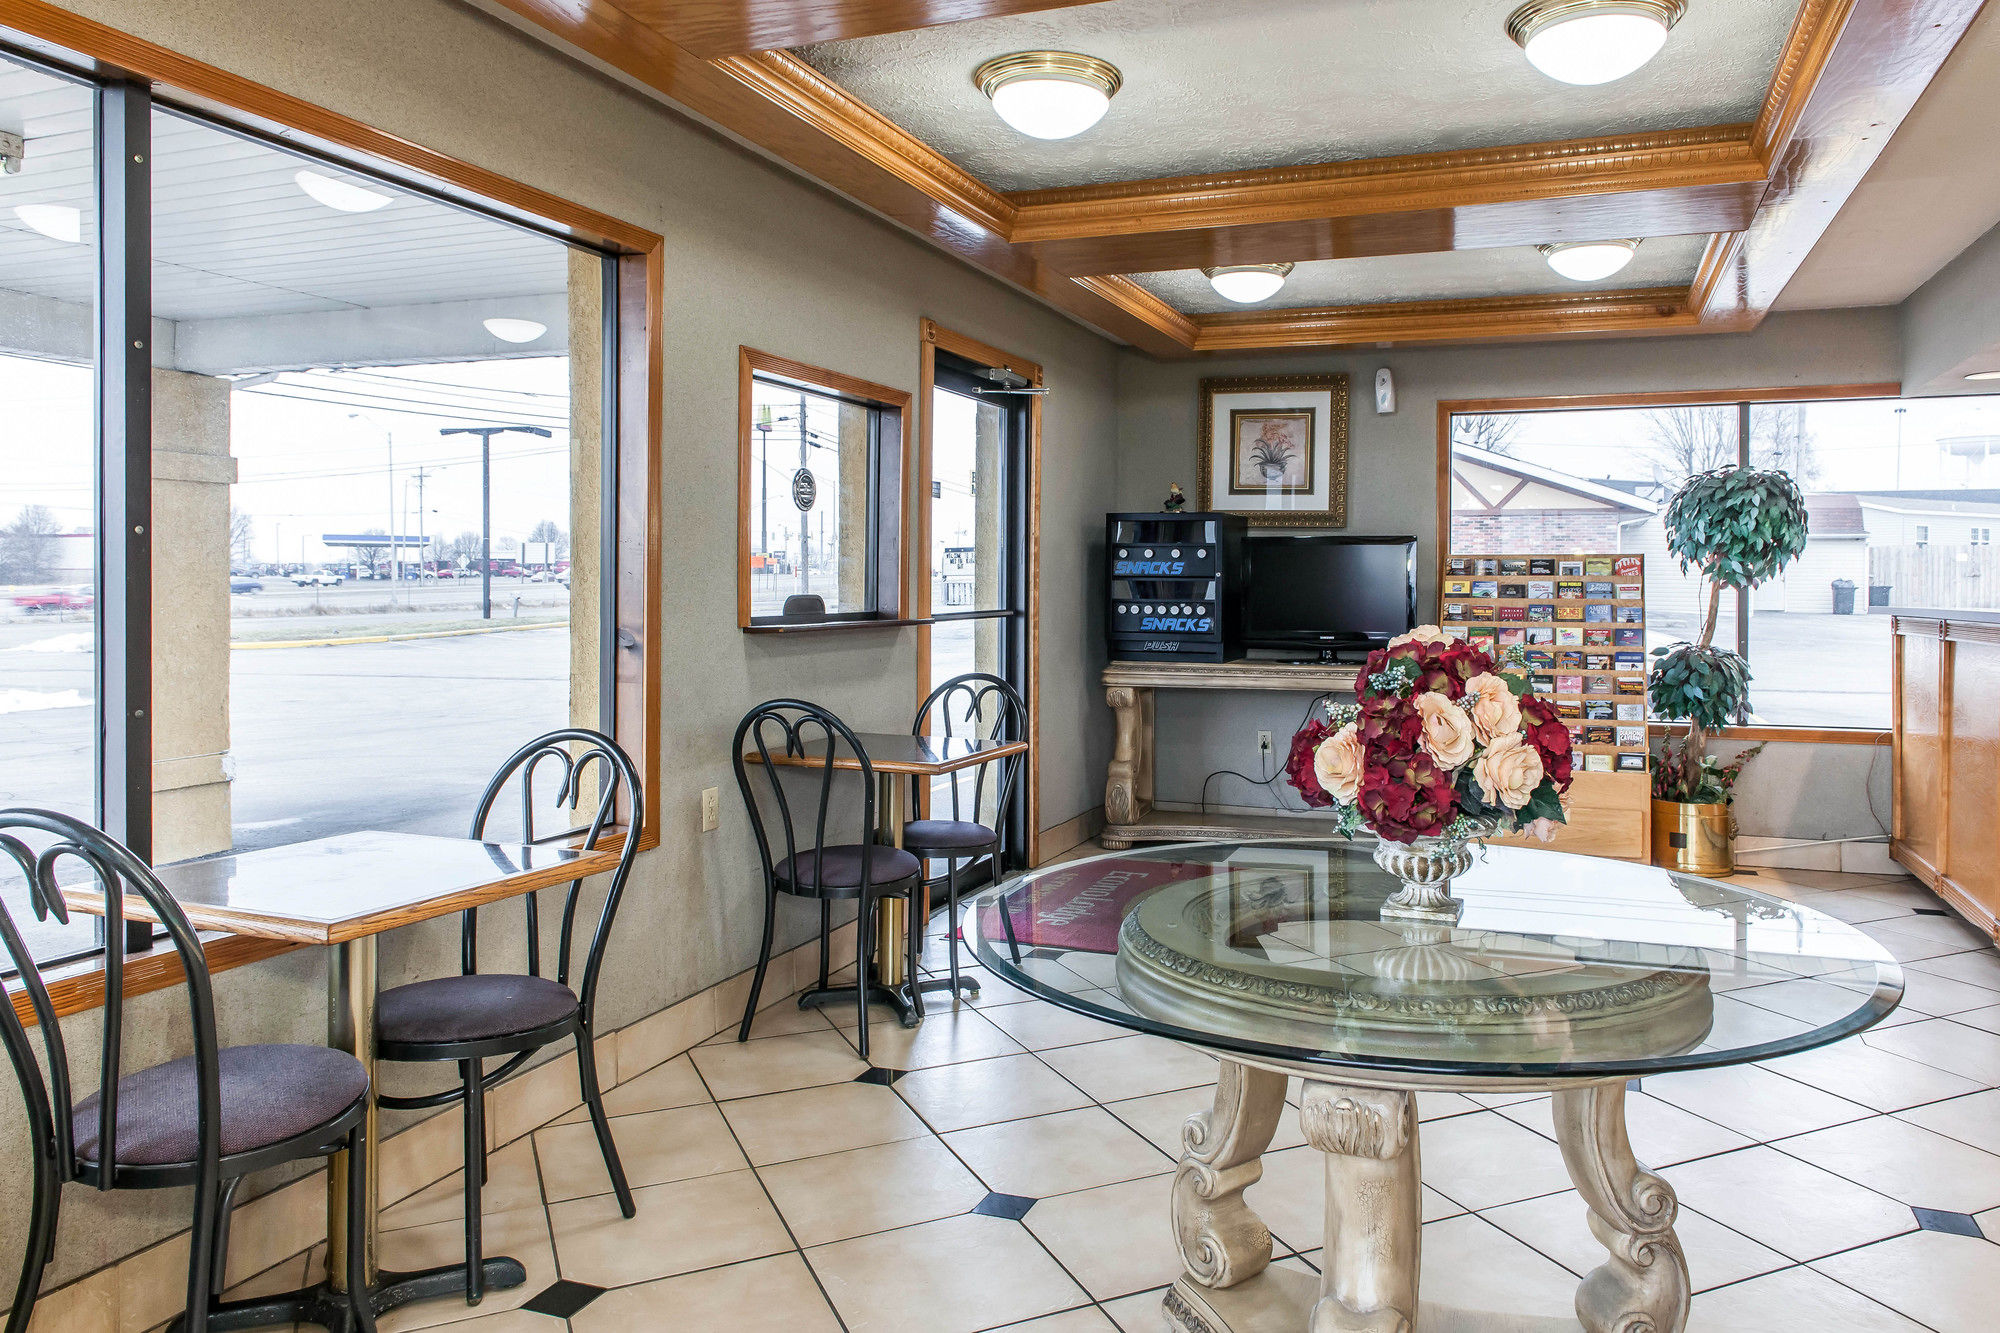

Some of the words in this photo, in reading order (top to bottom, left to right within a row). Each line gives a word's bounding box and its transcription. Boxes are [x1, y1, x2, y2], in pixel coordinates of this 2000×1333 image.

[1115, 561, 1185, 575] SNACKS
[1140, 617, 1212, 632] SNACKS
[1143, 641, 1179, 652] PUSH
